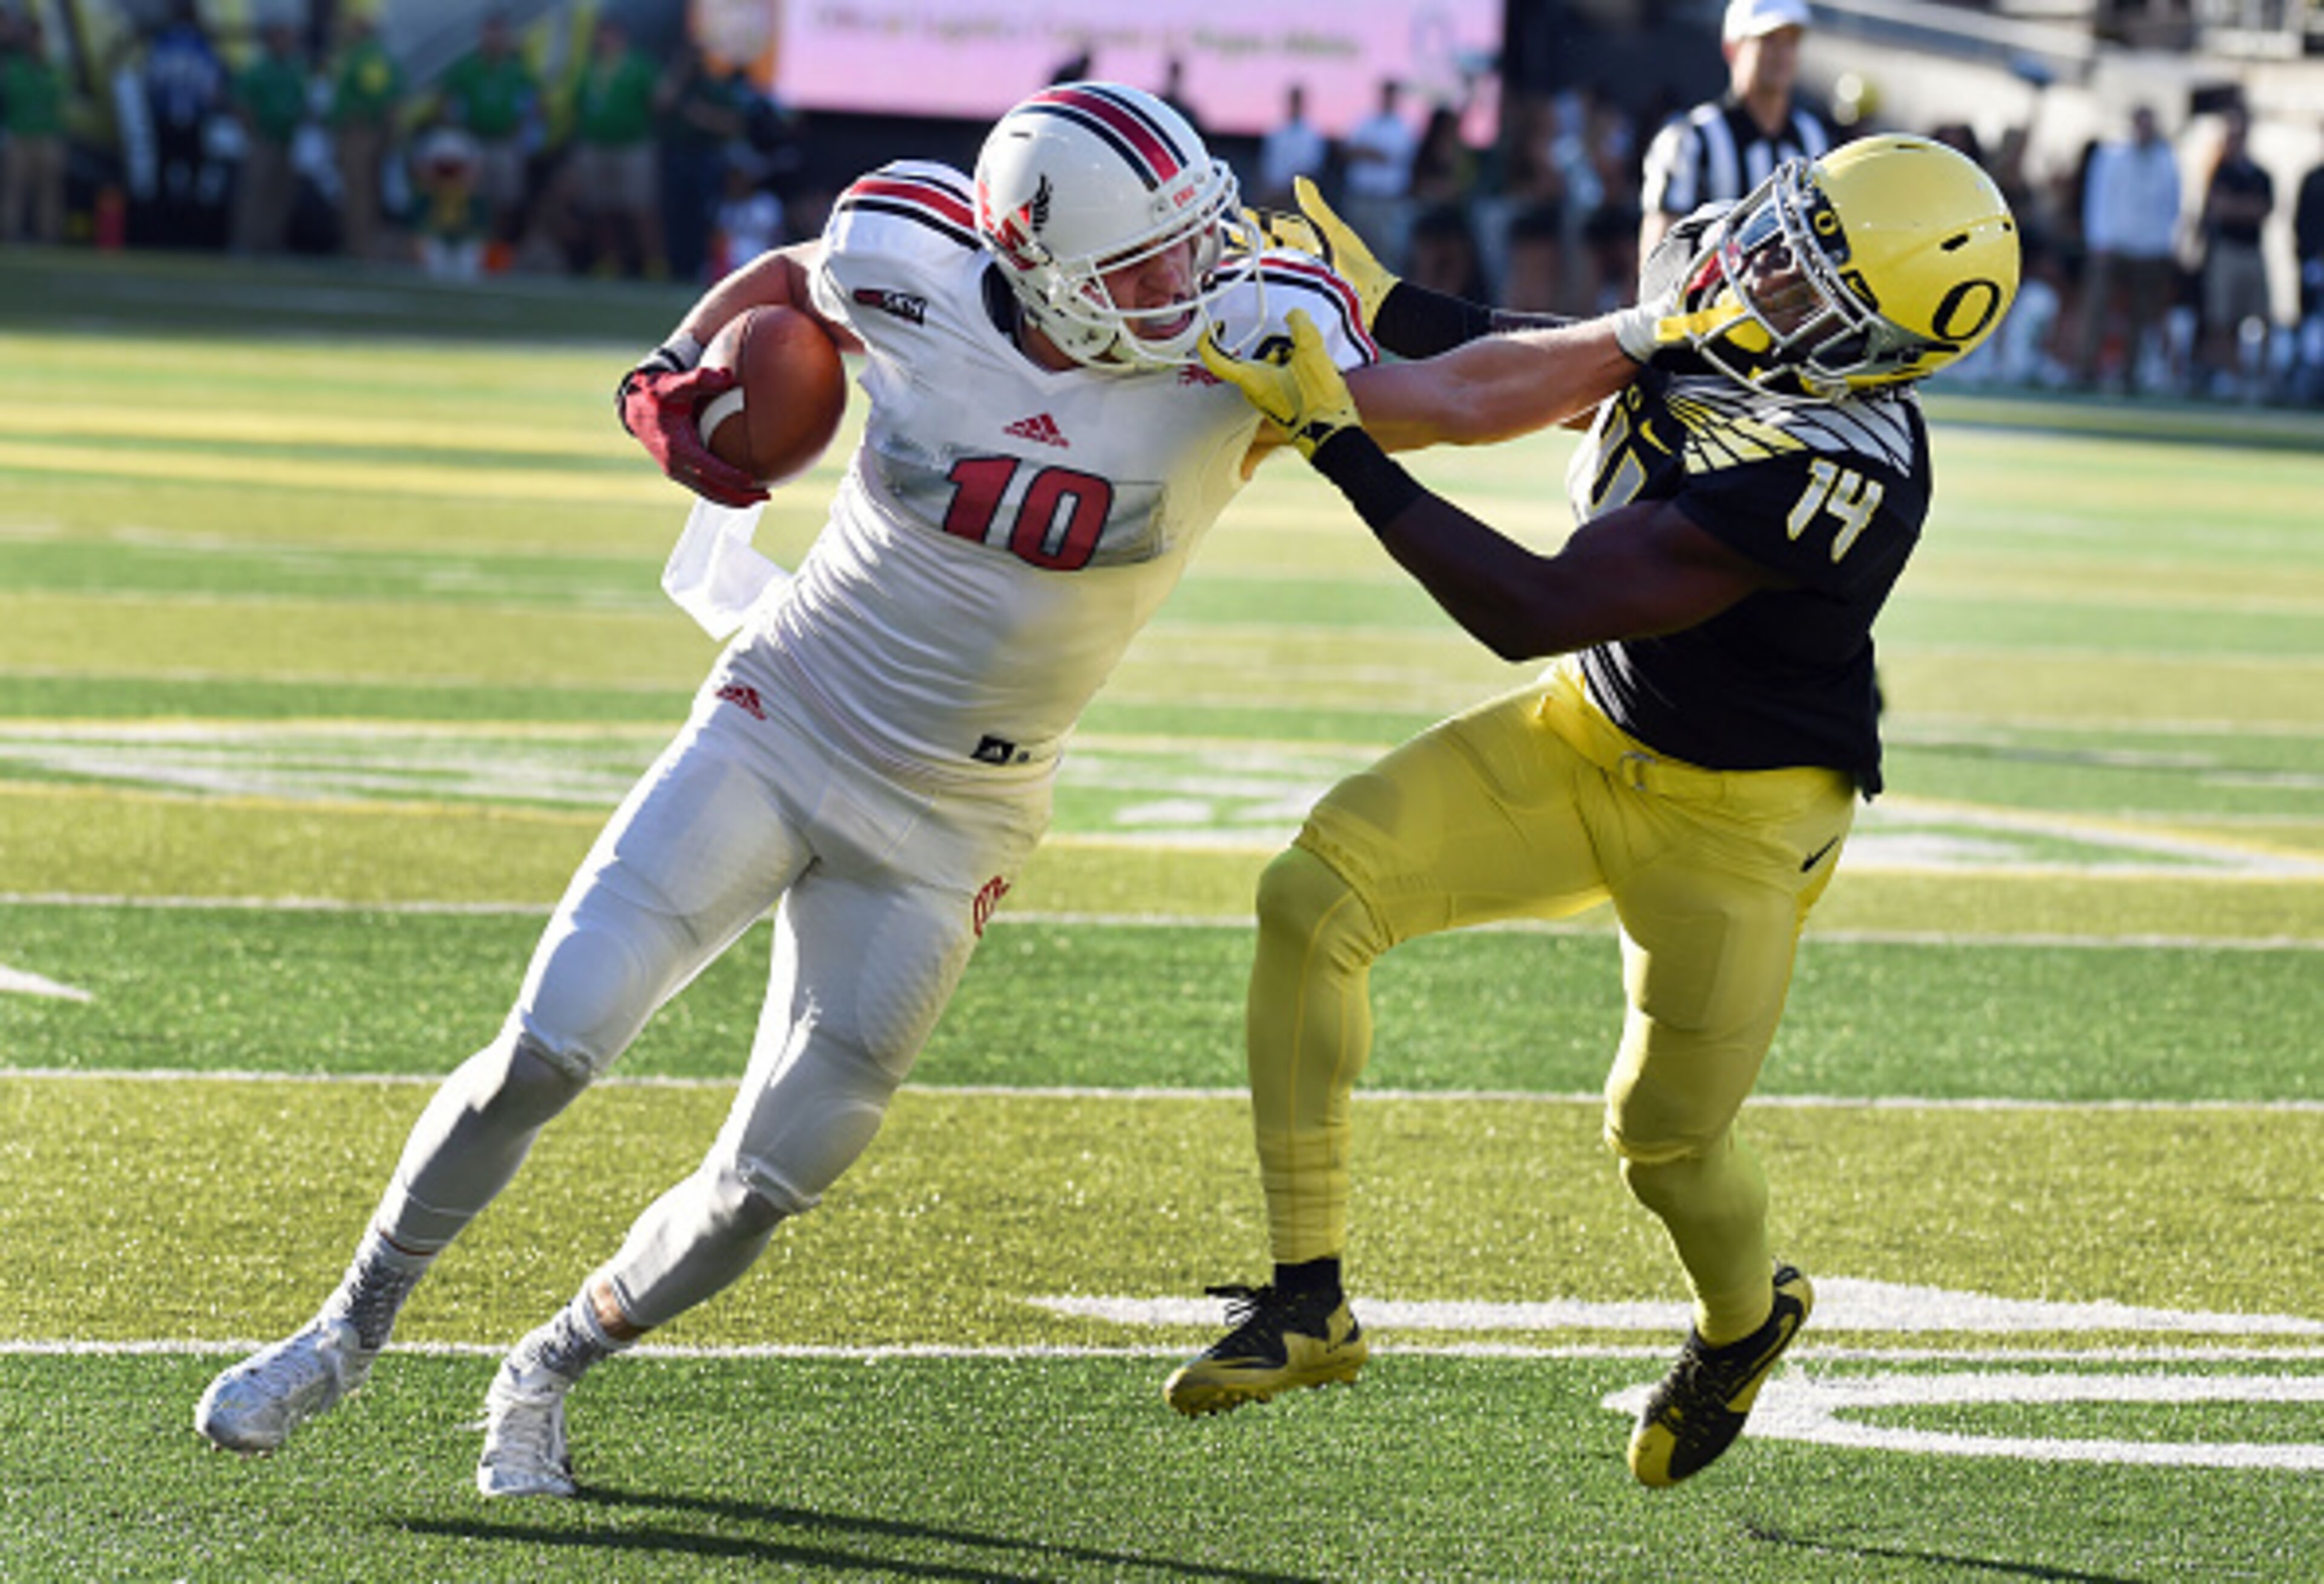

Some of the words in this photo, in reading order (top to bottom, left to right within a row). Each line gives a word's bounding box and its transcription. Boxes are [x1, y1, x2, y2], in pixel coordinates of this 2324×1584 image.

[1932, 279, 2000, 341] O
[942, 454, 1115, 571] 10
[1787, 457, 1883, 564] 14
